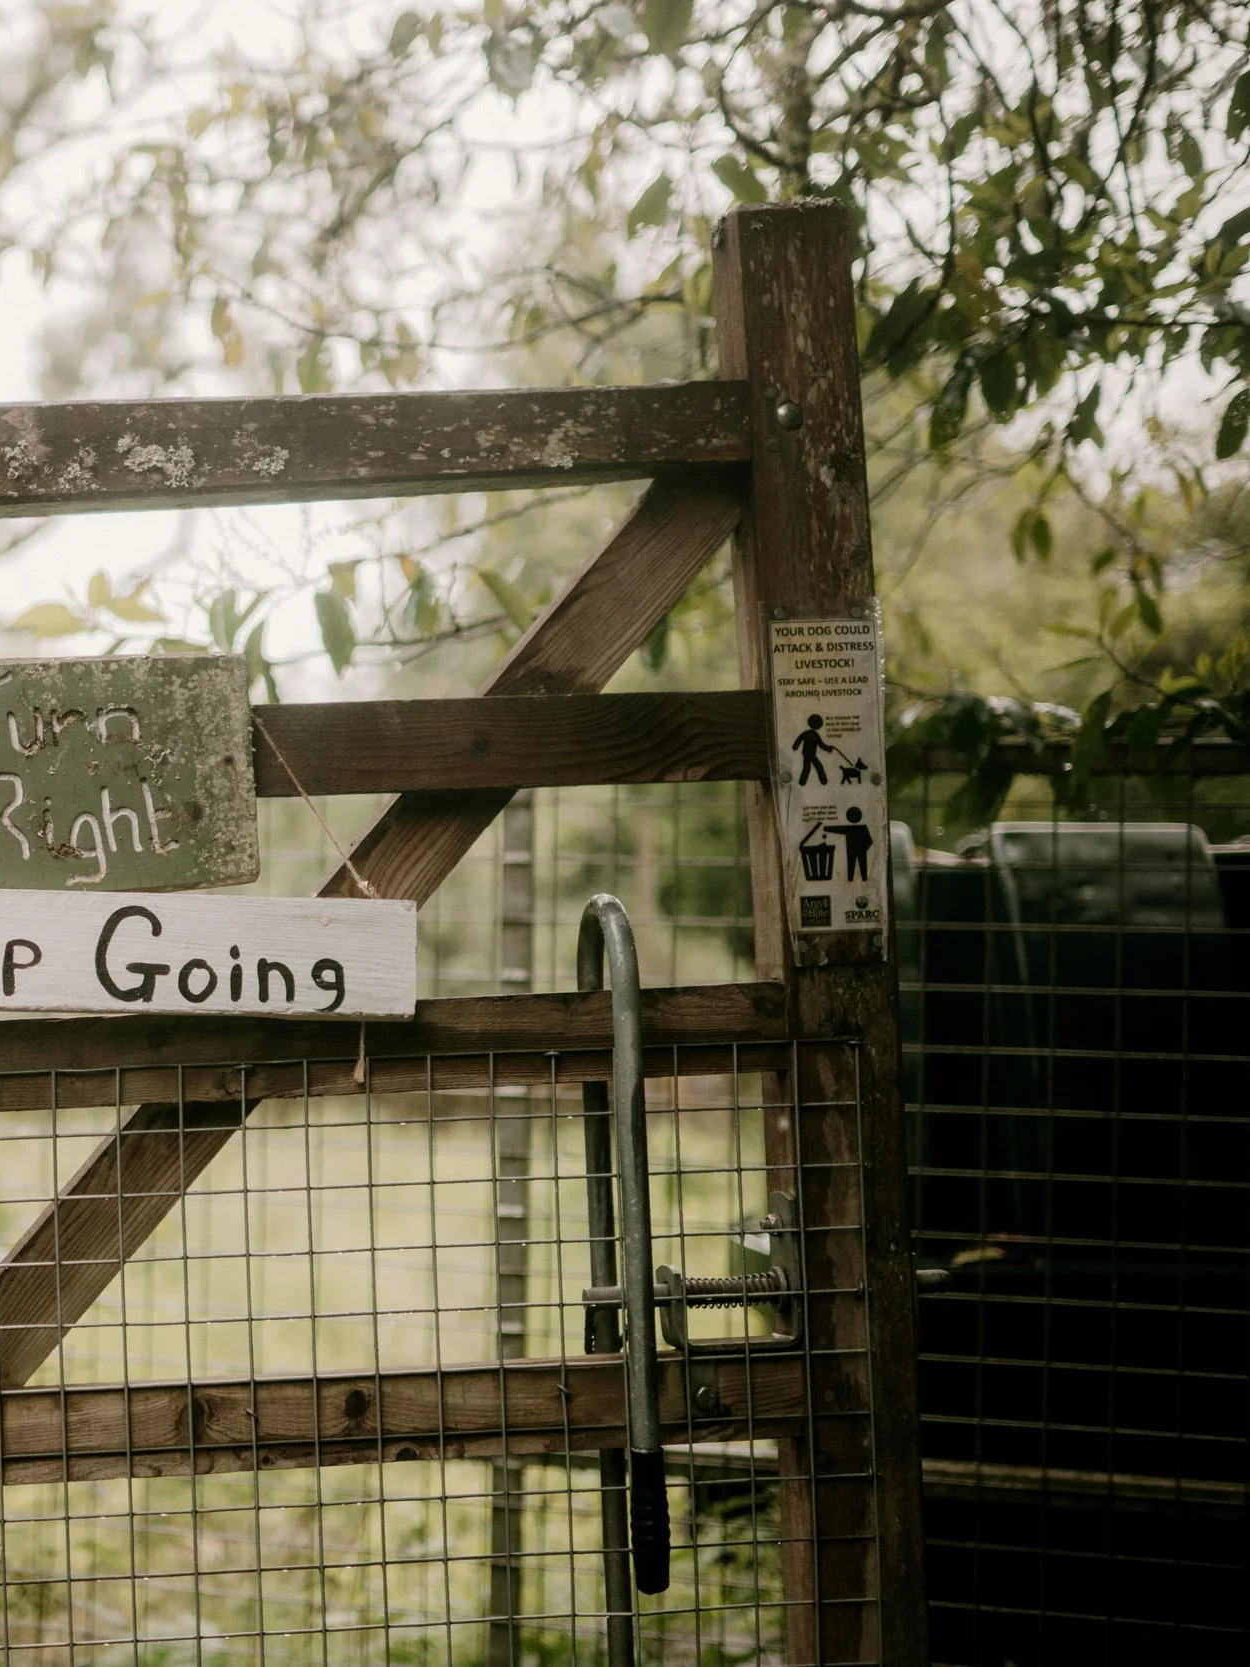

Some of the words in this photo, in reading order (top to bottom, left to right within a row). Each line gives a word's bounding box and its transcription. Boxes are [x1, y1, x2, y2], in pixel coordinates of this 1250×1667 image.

[775, 627, 805, 637] YOUR
[807, 626, 831, 636] DOG
[835, 625, 870, 635] COULD
[774, 643, 812, 653] ATTACK
[815, 642, 823, 652] &
[827, 641, 874, 652] DISTRESS
[795, 658, 855, 669] LIVESTOCK!
[778, 678, 795, 686] STAY
[797, 677, 816, 685] SAFE
[824, 677, 839, 685] USE
[841, 676, 847, 684] A
[848, 675, 869, 684] LEAD
[785, 689, 820, 698] AROUND
[822, 688, 862, 697] LIVESTOCK
[845, 909, 880, 920] SPARC
[93, 905, 347, 1012] Going
